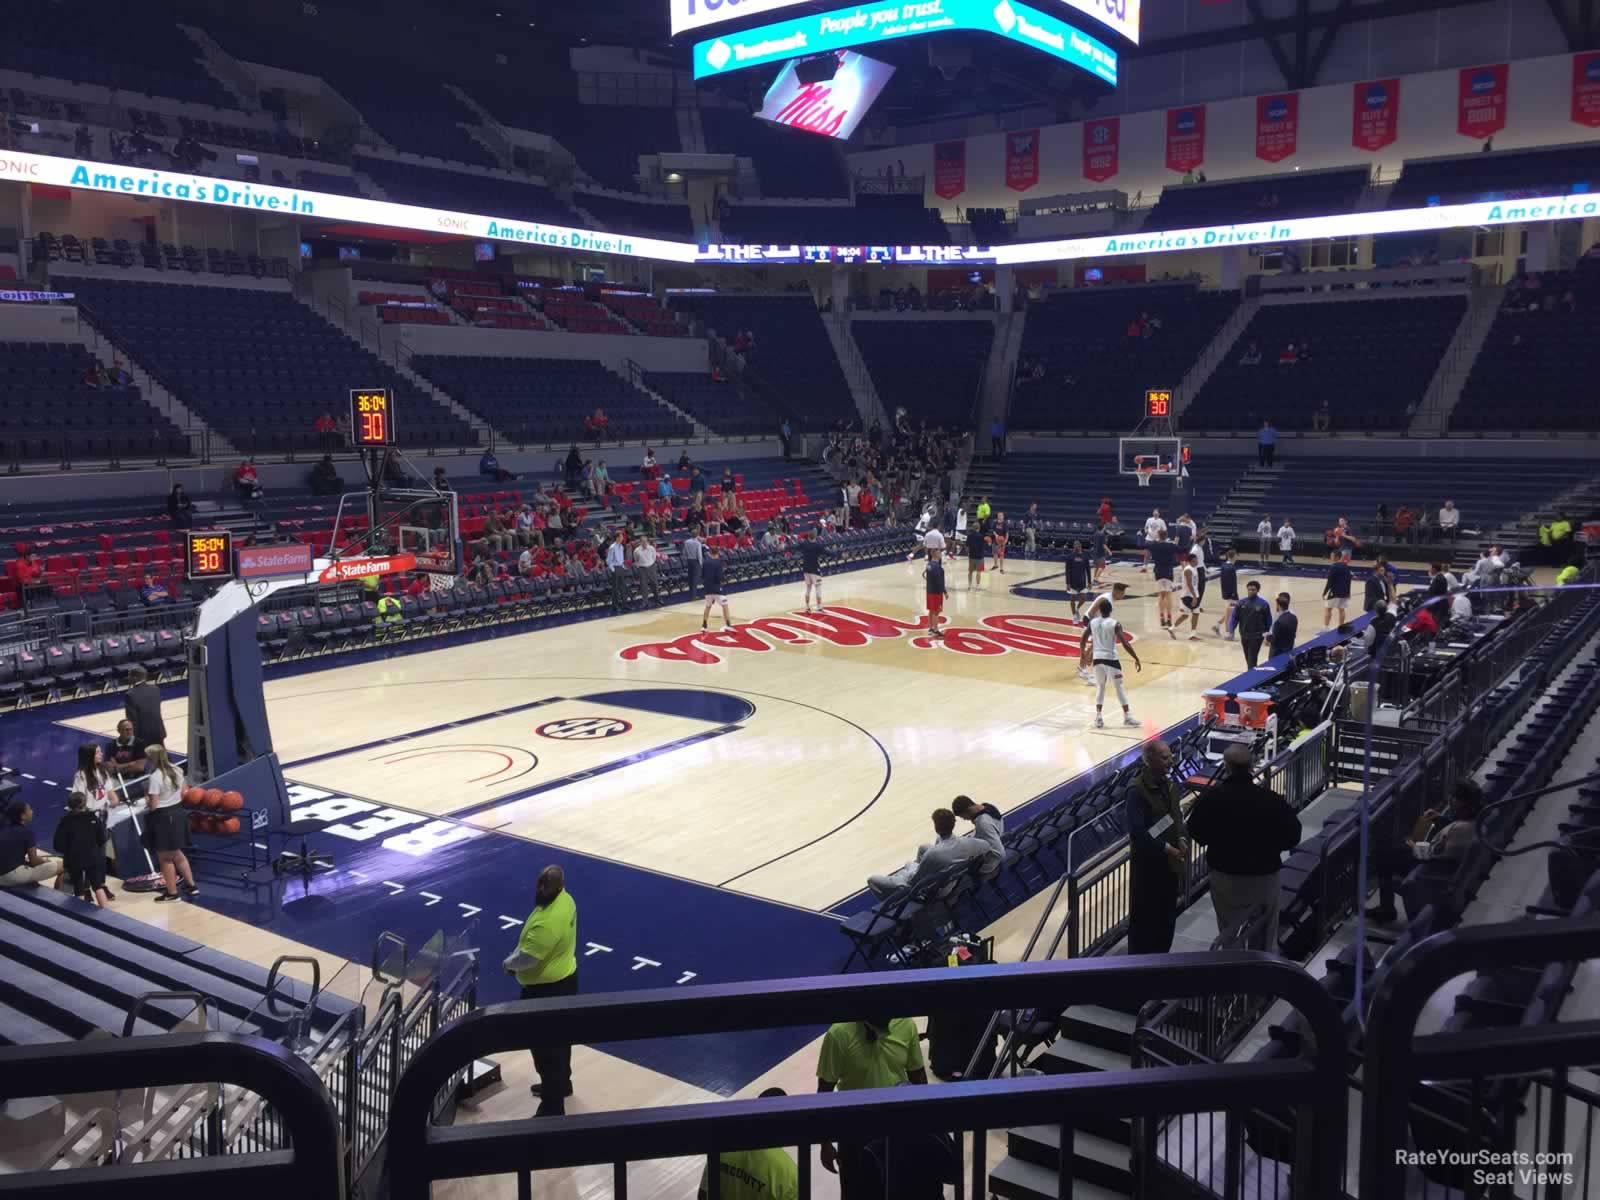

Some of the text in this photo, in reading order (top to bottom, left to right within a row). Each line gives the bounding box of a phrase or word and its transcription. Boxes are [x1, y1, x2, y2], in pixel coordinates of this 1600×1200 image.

[0, 159, 39, 175] ONIC
[70, 165, 206, 200] America's
[487, 221, 567, 246] America's
[1105, 231, 1198, 252] America's
[358, 395, 385, 411] 36:04
[1149, 393, 1169, 401] 36:04
[1151, 401, 1167, 414] 30
[362, 413, 383, 440] 30
[192, 538, 224, 552] 36:04
[199, 553, 219, 570] 30
